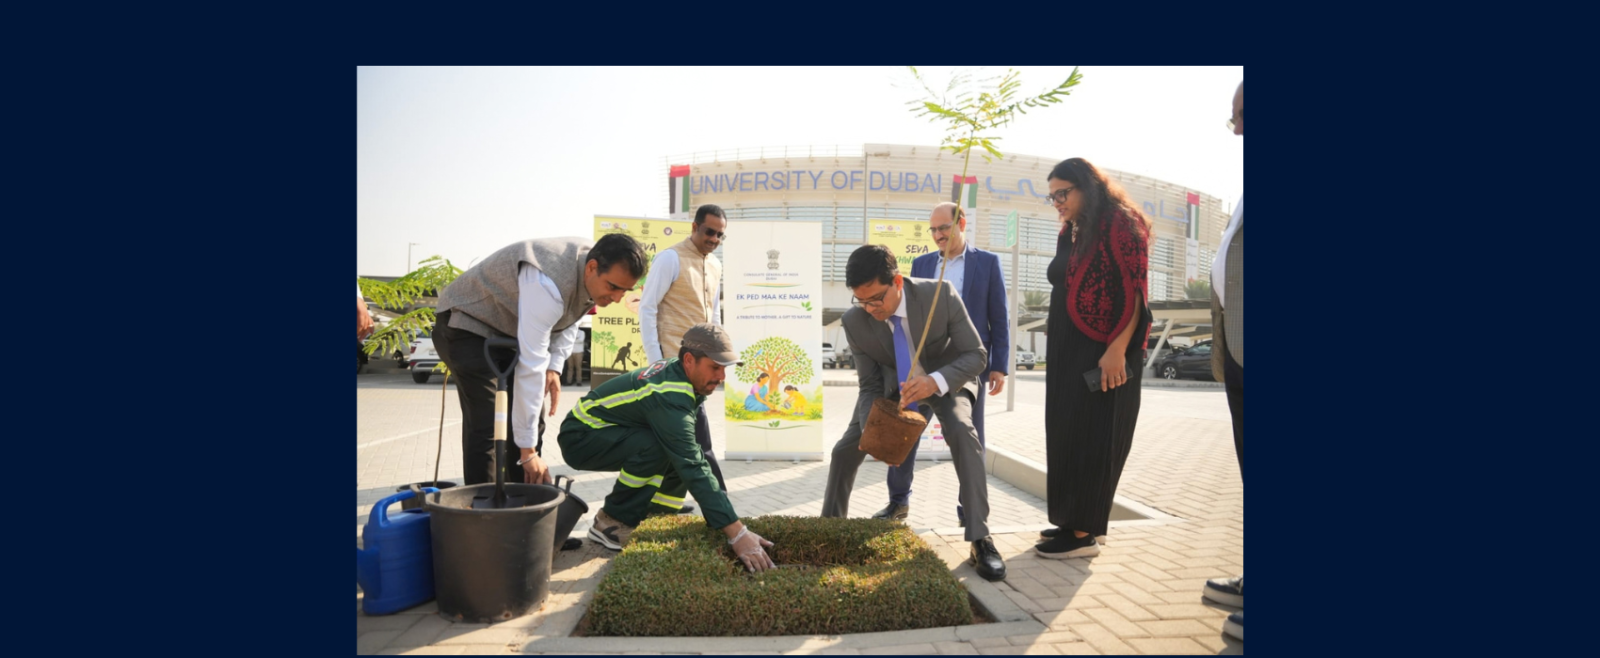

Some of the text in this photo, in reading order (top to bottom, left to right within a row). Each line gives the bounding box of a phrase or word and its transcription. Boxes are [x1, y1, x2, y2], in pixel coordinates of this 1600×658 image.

[690, 170, 942, 195] UNIVERSITY OF DUBAI
[905, 245, 929, 253] SEVA
[598, 317, 623, 325] TREE
